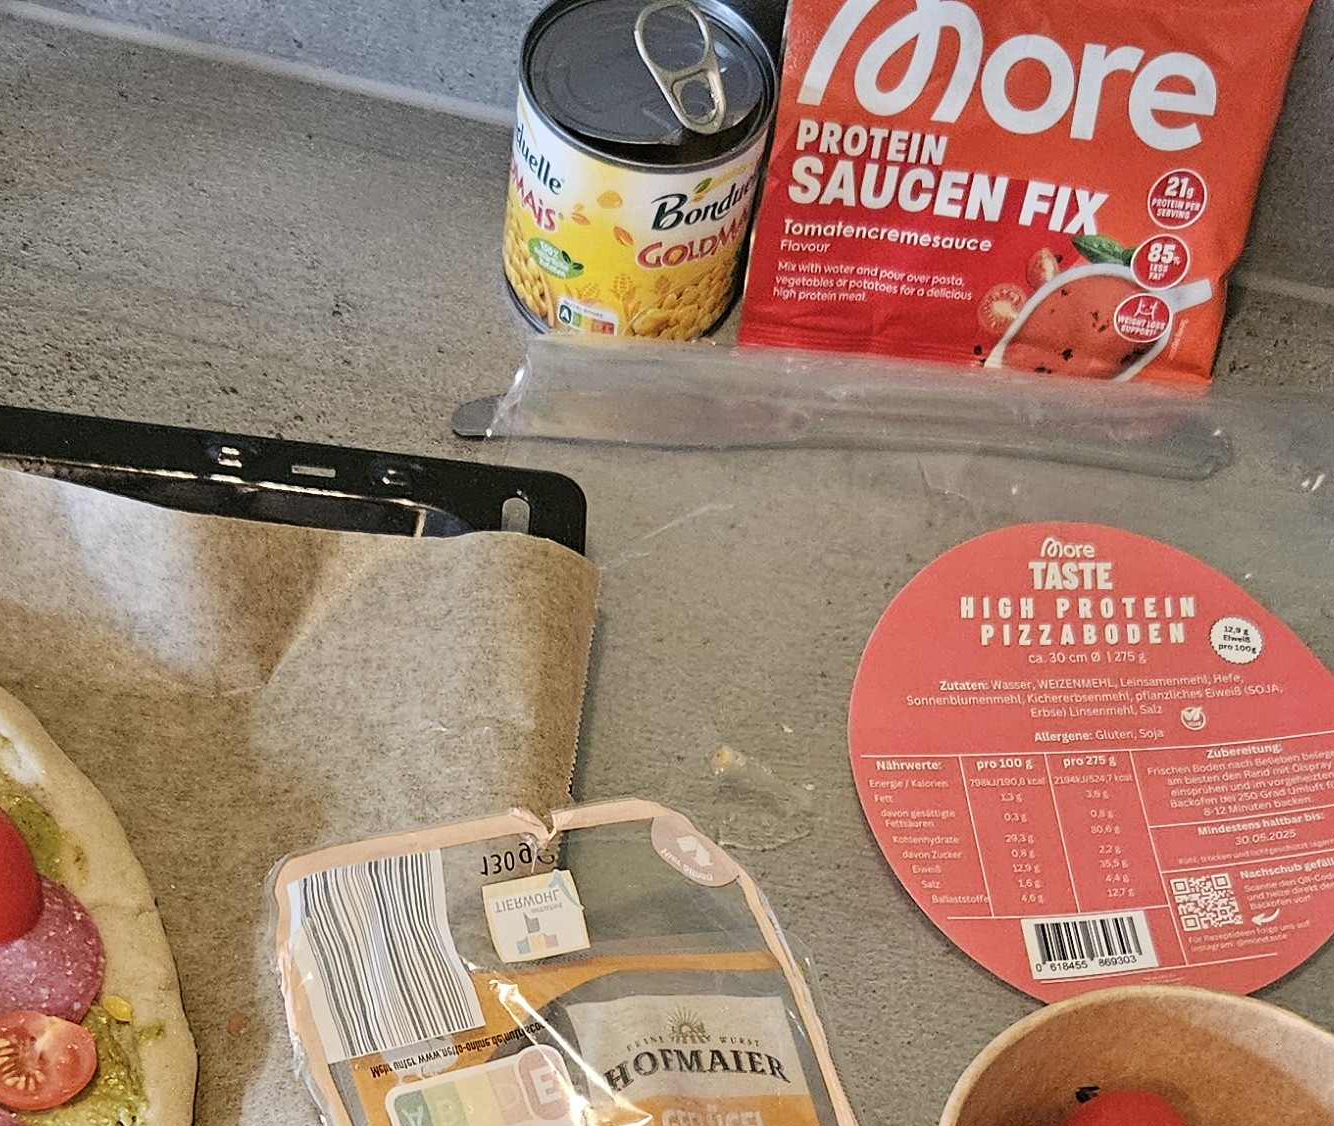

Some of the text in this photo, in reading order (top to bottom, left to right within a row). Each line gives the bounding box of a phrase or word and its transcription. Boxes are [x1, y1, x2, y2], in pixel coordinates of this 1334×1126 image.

[797, 0, 1217, 151] More
[795, 119, 948, 165] PROTEIN
[787, 156, 1109, 235] SAUCEN FIX
[1156, 208, 1190, 220] SERVING
[784, 219, 993, 251] Tomatencremesauce
[780, 239, 830, 253] Flavour
[778, 261, 931, 283] Mix with water and pour over
[773, 287, 836, 302] high protein
[775, 275, 972, 301] vegetables potatoes delicious
[1117, 315, 1146, 328] WEIGHT
[1040, 537, 1096, 559] More
[1028, 561, 1114, 590] TASTE
[960, 595, 1197, 619] HIGH PROTEIN
[980, 622, 1186, 646] PIZZABODEN
[1028, 651, 1135, 664] ca. 30 cm 275
[939, 672, 1245, 692] Zutaten: Wasser, WEIZENMEHL, Leinsamenmehl, Hefe,
[906, 684, 1284, 706] Sonnenblumenmehl, Kichererbsenmehl, pflanzliches Eiweiß (SOJA,
[1031, 704, 1163, 718] Erbse) Linsenmehl, Salz
[1034, 727, 1164, 743] Allergene: Gluten, Soja
[1206, 743, 1283, 760] Zubereitung:
[876, 756, 1106, 771] Nährwerte: pro 100 pro 275
[1147, 766, 1191, 776] Frischen
[1192, 762, 1226, 773] Boden
[1228, 759, 1253, 770] nach
[1255, 754, 1300, 767] Belieben
[1184, 760, 1333, 785] besten Rand Ölspray
[869, 779, 949, 790] Energie Kalorien
[1170, 771, 1334, 798] einsprühen vorgeheizten
[1170, 782, 1326, 809] Backofen Umluft
[880, 809, 956, 819] davon gesättigte
[1228, 801, 1273, 815] Minuten
[885, 819, 935, 828] Fettsäuren
[1197, 814, 1303, 836] Mindestens haltbar
[892, 835, 960, 846] Kohlenhydrate
[1235, 829, 1297, 847] 30.05.2025
[901, 850, 962, 859] davon Zucker
[912, 864, 942, 874] Eiweiß
[1240, 863, 1302, 880] Nachschub
[921, 879, 941, 889] Salz
[1243, 882, 1278, 893] Scanne
[932, 894, 990, 904] Ballaststoffe
[1249, 898, 1293, 911] Backofen
[1203, 928, 1255, 943] Rezeptideen
[1050, 954, 1138, 972] 618455 869303
[719, 1036, 760, 1047] WURST
[603, 1048, 792, 1093] HOFMAIER
